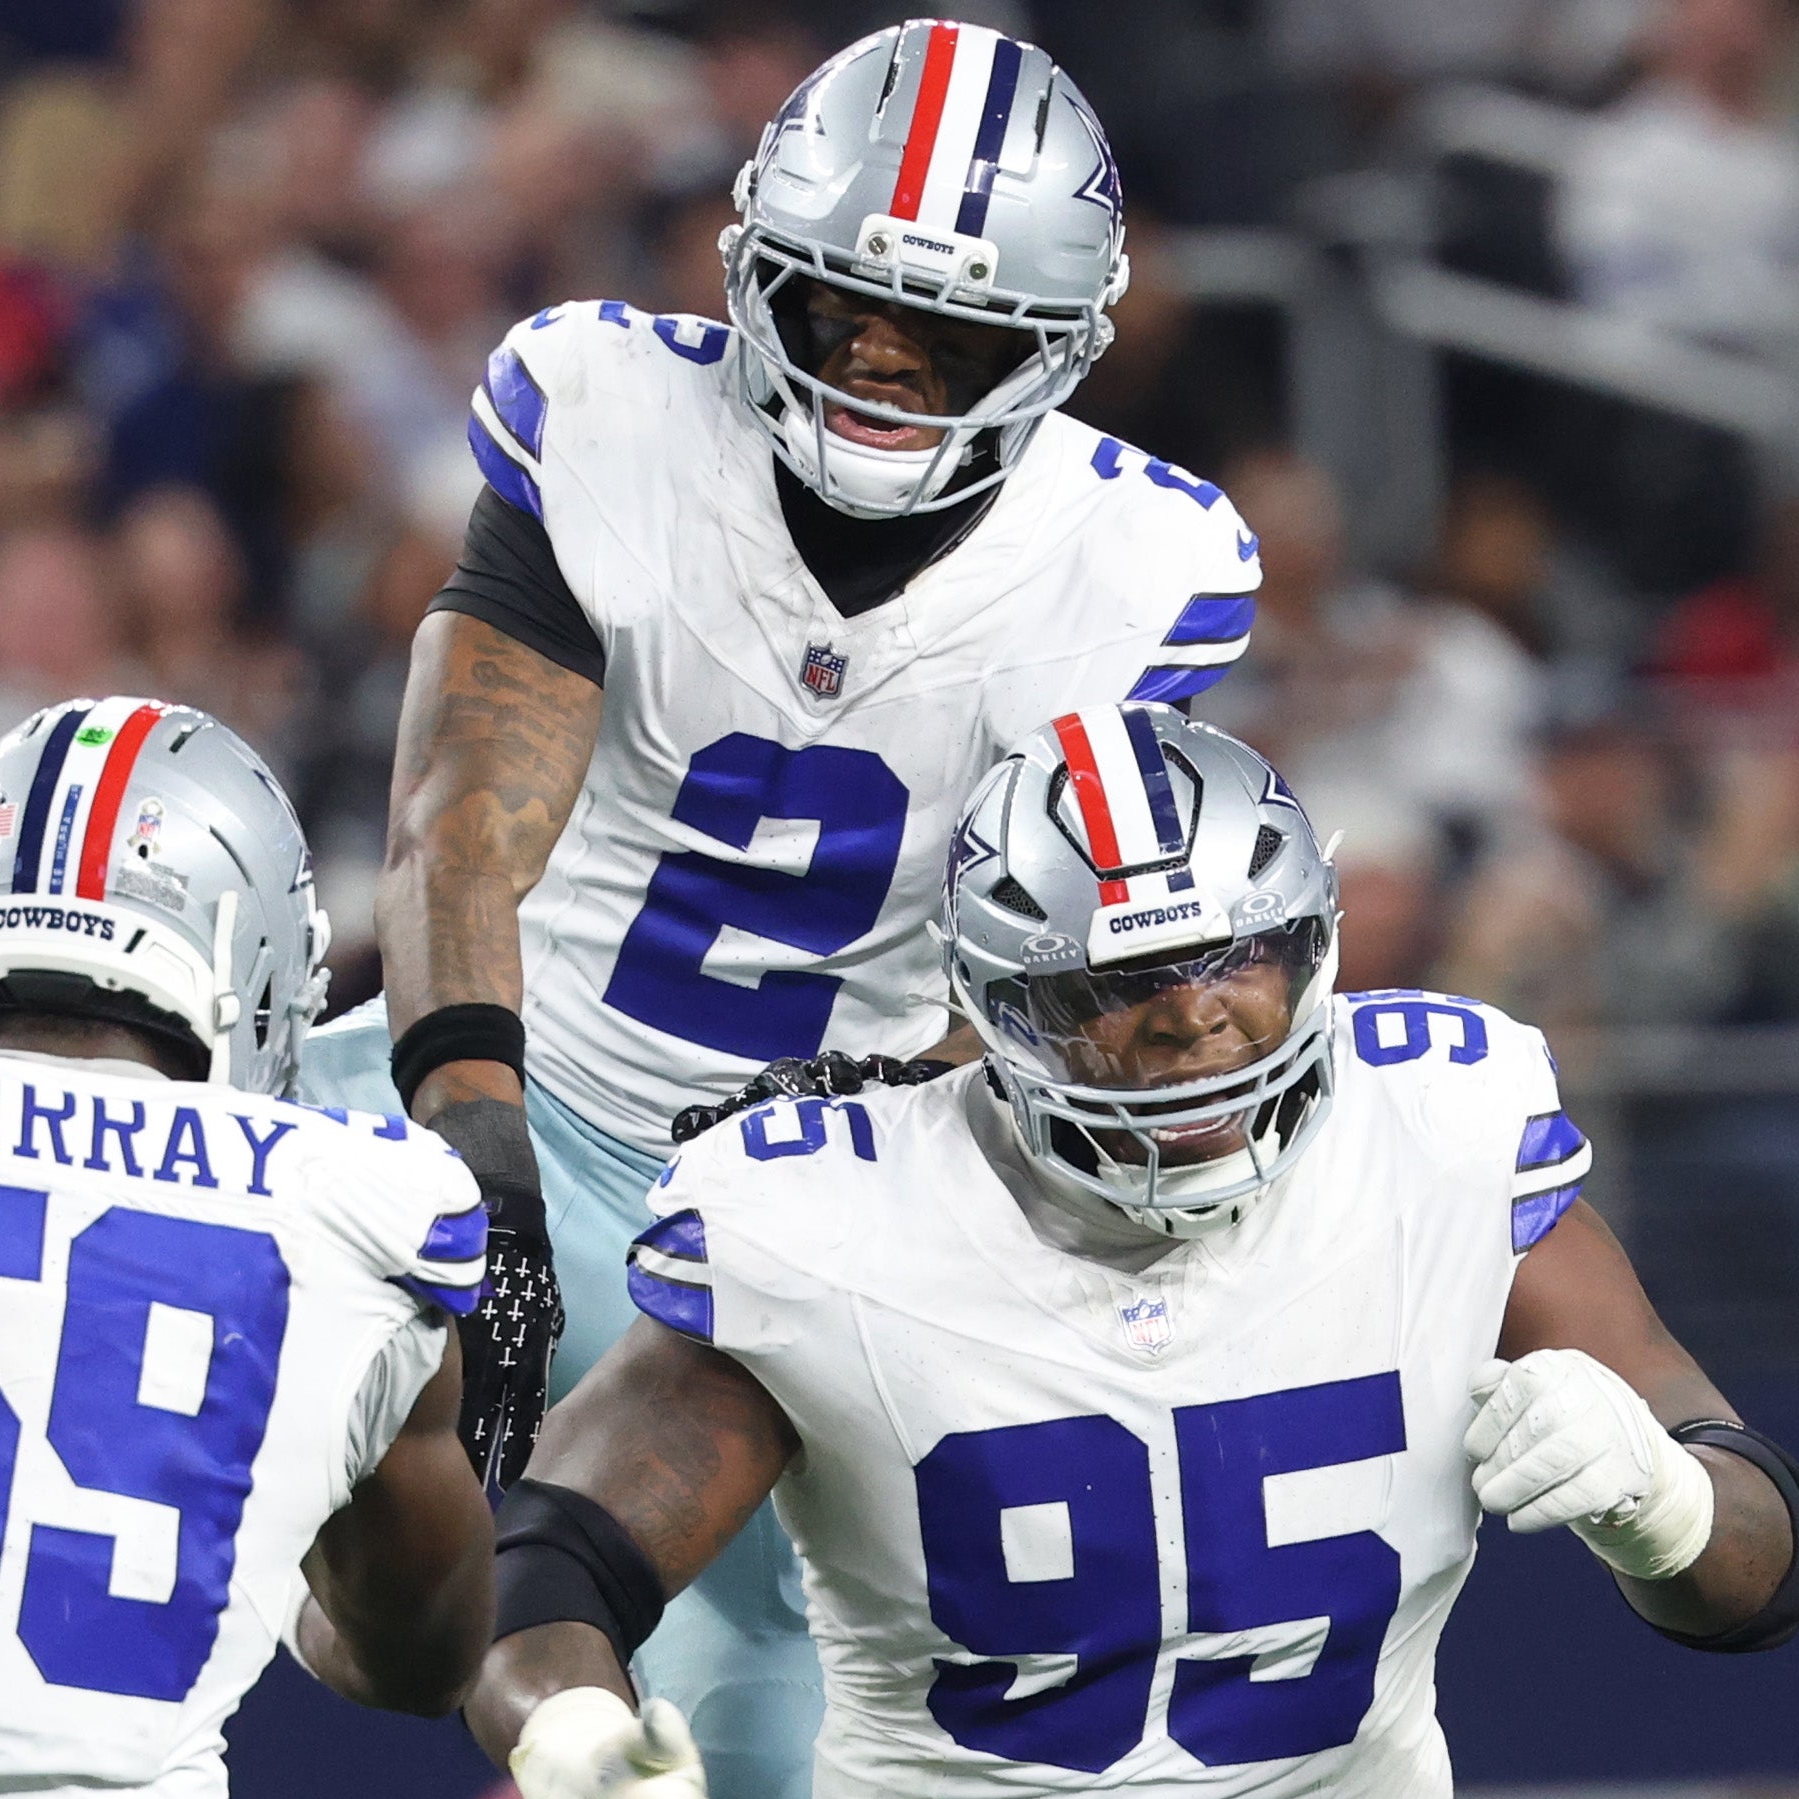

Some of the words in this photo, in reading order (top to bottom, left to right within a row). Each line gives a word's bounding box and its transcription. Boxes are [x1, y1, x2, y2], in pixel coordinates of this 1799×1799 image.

[902, 234, 955, 255] COWBOYS
[601, 731, 910, 1063] 2
[1109, 902, 1202, 934] COWBOYS
[1023, 948, 1079, 965] OAKLEY
[914, 1369, 1407, 1774] 95
